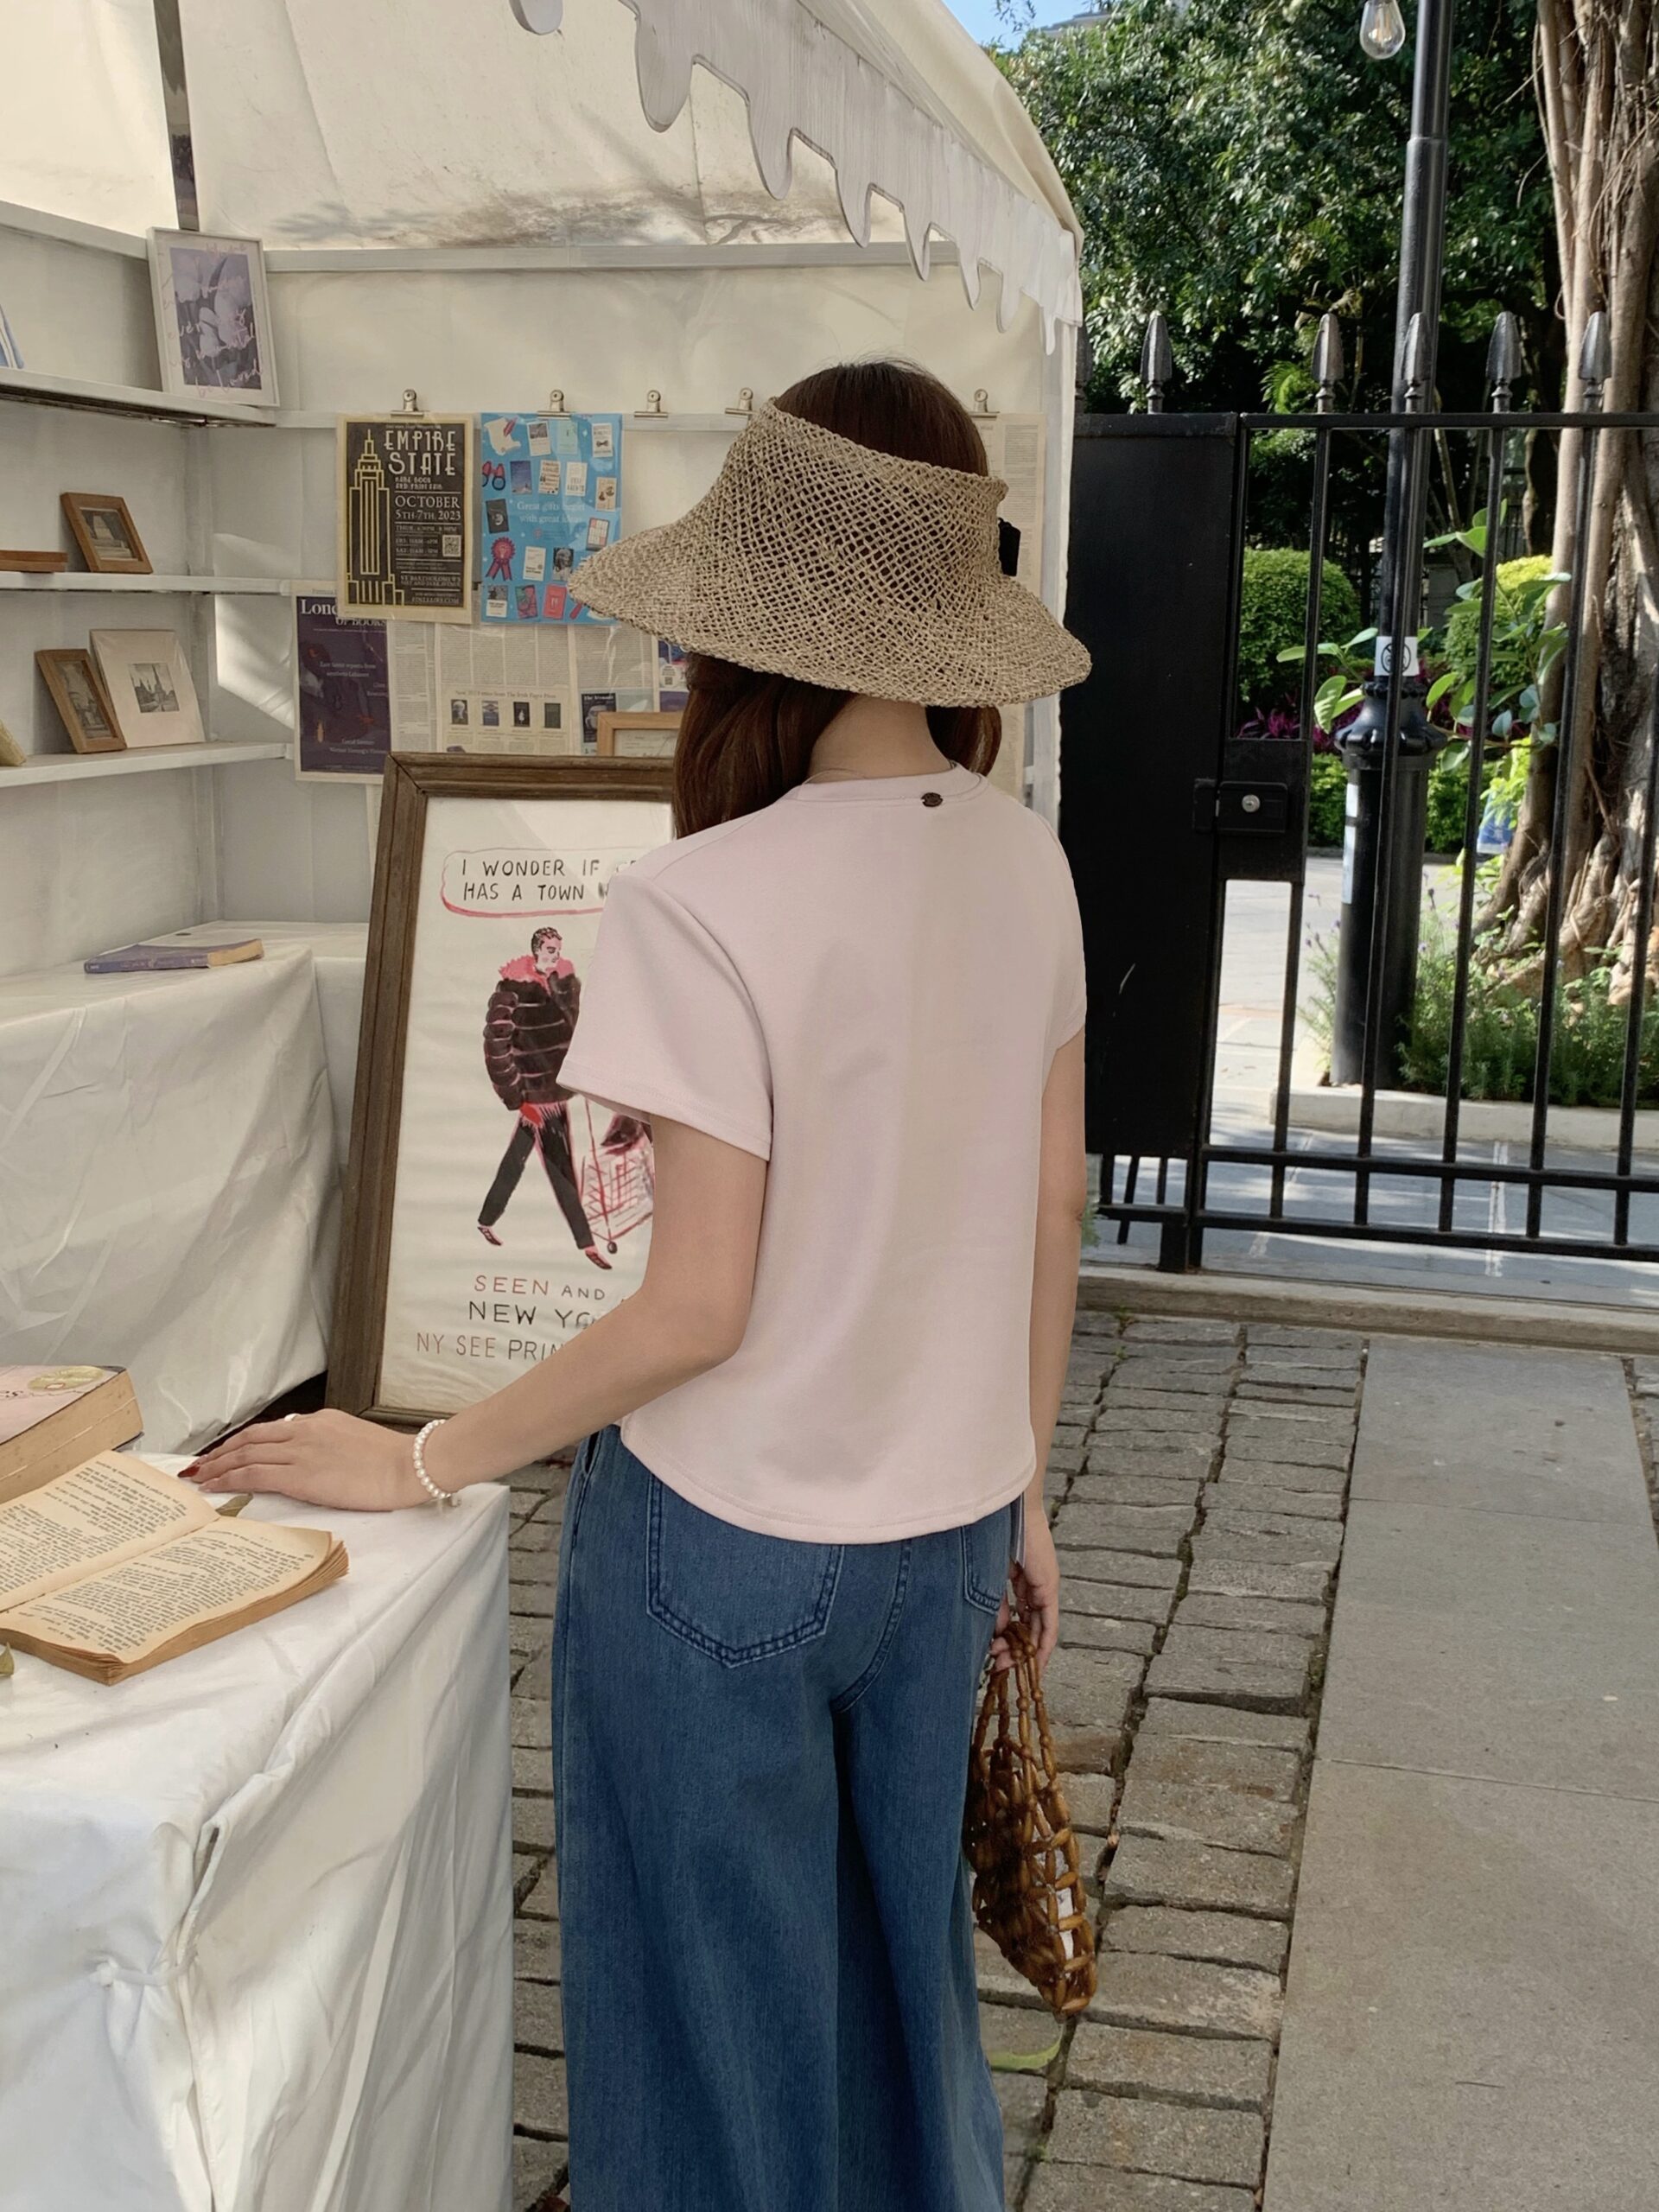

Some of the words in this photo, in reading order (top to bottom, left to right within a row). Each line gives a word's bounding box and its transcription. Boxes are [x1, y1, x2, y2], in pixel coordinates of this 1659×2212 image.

[384, 430, 455, 451] EMPIRE
[388, 451, 455, 475] STATE
[395, 495, 461, 508] OCTOBER
[517, 501, 540, 511] Great
[438, 511, 461, 520] 2023
[520, 514, 537, 523] with
[461, 859, 467, 875] I
[482, 859, 565, 877] WONDER
[582, 859, 600, 876] IF
[463, 882, 499, 900] HAS
[512, 884, 522, 901] A
[537, 884, 584, 900] TOWN
[474, 1274, 549, 1295] SEEN
[561, 1285, 605, 1300] AND
[469, 1301, 536, 1325] NEW
[555, 1309, 595, 1329] YO
[416, 1332, 444, 1354] NY
[456, 1335, 496, 1357] SEE
